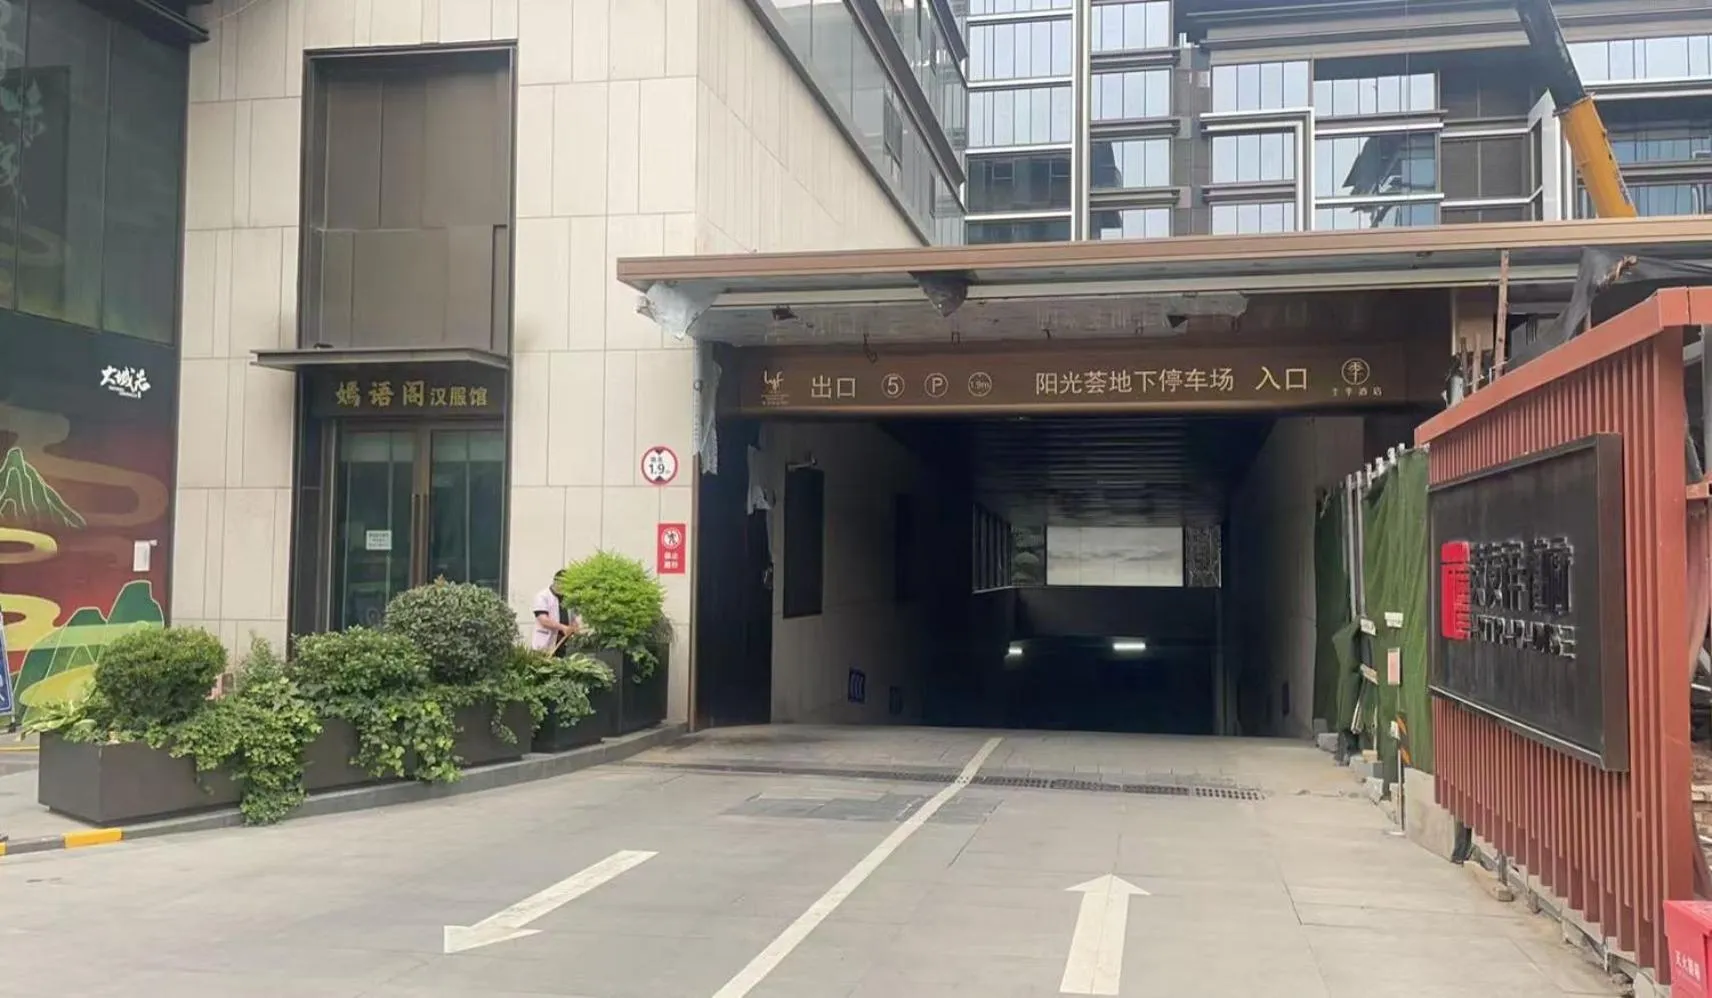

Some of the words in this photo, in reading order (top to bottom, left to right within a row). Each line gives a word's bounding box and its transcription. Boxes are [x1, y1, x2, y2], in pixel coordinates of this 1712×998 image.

[811, 374, 857, 400] 出口
[886, 376, 900, 395] 5
[930, 376, 943, 394] P
[1035, 367, 1234, 395] 阳光荟地下停车场
[1255, 366, 1308, 392] 入口
